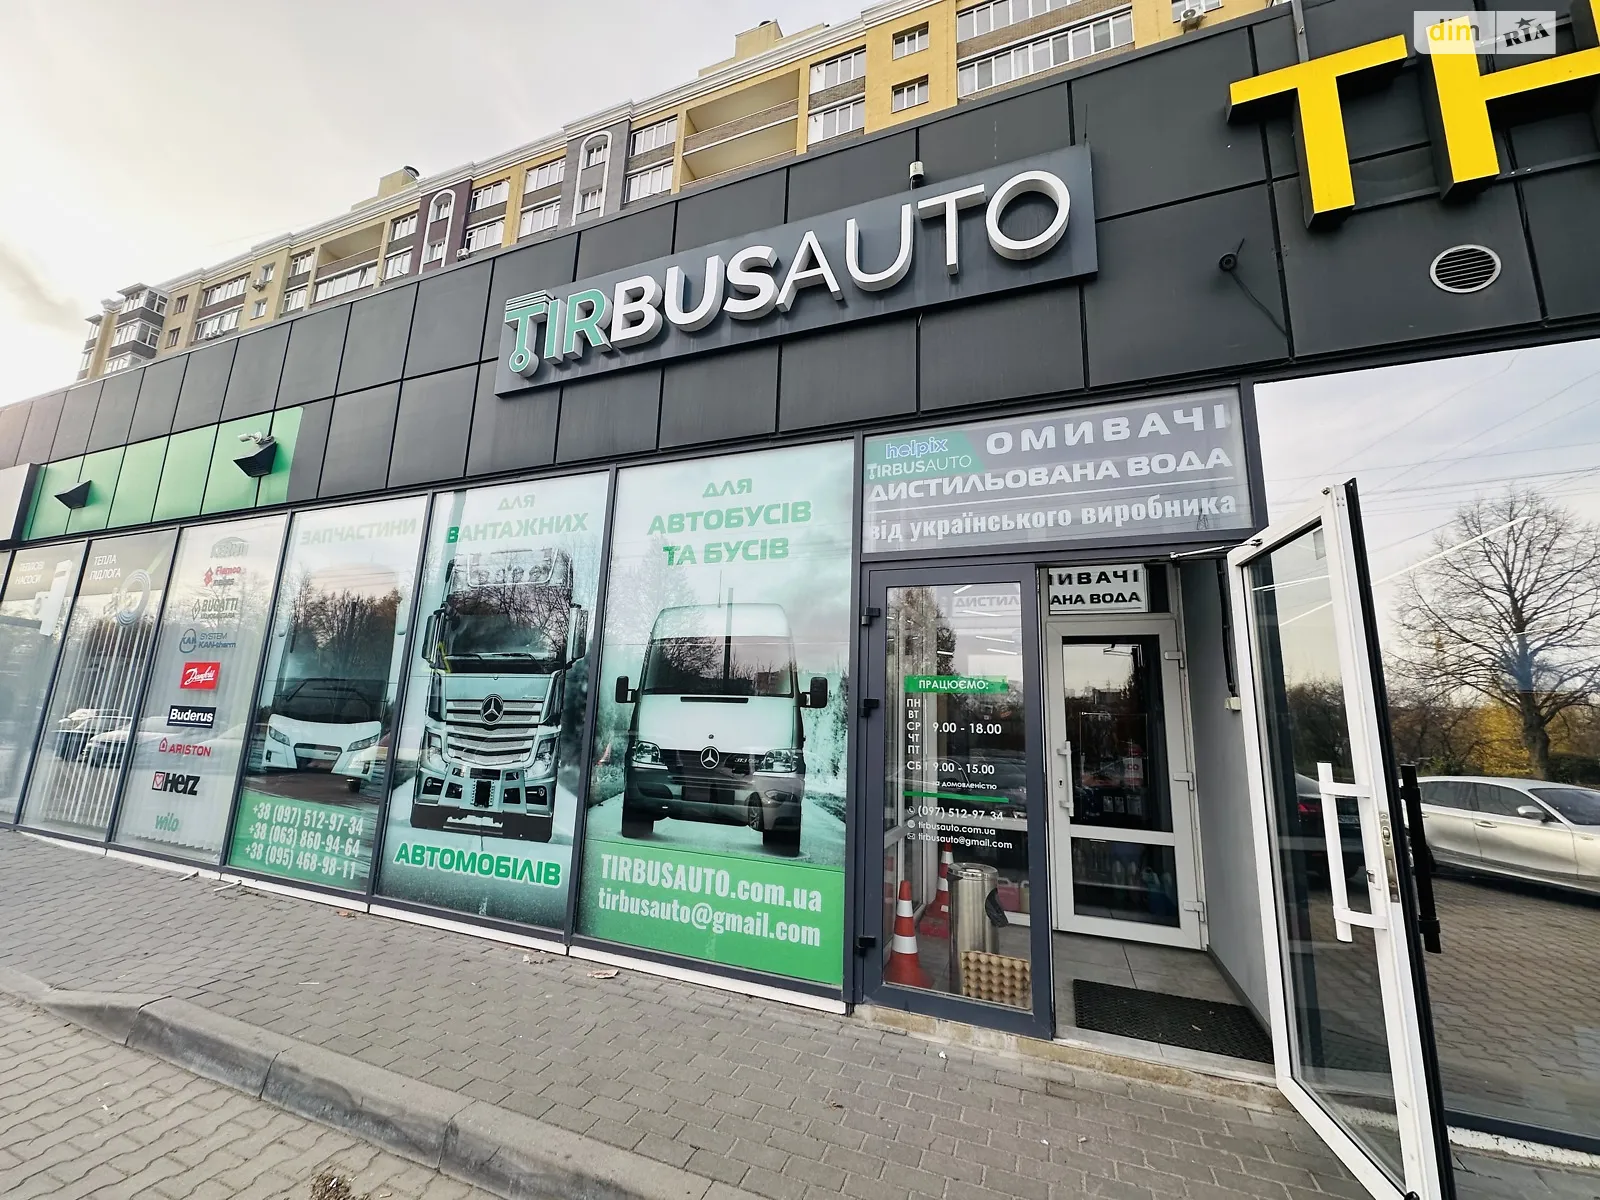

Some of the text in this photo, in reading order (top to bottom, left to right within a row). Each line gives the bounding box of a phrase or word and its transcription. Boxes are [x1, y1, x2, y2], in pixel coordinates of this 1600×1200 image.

[504, 170, 1071, 378] TIRBUSAUTO
[986, 404, 1226, 455] ОМИВАЧІ
[885, 436, 949, 459] helpix
[867, 454, 972, 480] TIRBUSAUTO
[867, 448, 1232, 502] ДИСТИЛЬОВАНА ВОДА
[702, 478, 752, 498] ДЛЯ
[497, 494, 535, 511] ДЛЯ
[648, 501, 811, 535] АВТОБУСІВ
[870, 494, 1236, 543] від українського виробника
[300, 518, 417, 546] ЗАПЧАСТИНИ
[446, 512, 588, 544] ВАНТАЖНИХ
[663, 537, 789, 566] ТА БУСІВ
[94, 555, 117, 565] ТЕПЛА
[89, 568, 121, 581] ПІДЛОГА
[955, 596, 1021, 608] ДИСТИЛ
[1050, 592, 1142, 605] АНА ВОДА
[182, 636, 197, 644] KAN
[200, 632, 228, 640] SYSTEM
[919, 680, 989, 690] ПРАЦЮЄМО:
[907, 698, 921, 707] ПН
[170, 708, 214, 723] Buderus
[908, 710, 919, 719] ВТ
[907, 722, 921, 731] СР
[933, 722, 957, 733] 9.00
[969, 723, 1002, 735] 18.00
[908, 733, 920, 742] ЧТ
[168, 744, 212, 757] ARISTON
[908, 745, 920, 754] ПТ
[907, 761, 922, 770] СБ
[933, 763, 955, 772] 9.00
[966, 763, 995, 775] 15.00
[941, 781, 998, 790] домовленістю
[253, 802, 364, 836] +38 (097) 512-97-34
[918, 805, 1004, 821] (097) 512-9734
[155, 813, 180, 832] wilo
[918, 821, 996, 836] tirbusauto.com.ua
[249, 821, 361, 858] +38 (063) 860-94-64
[918, 833, 1013, 849] tirbusauto@gmail.com
[245, 841, 356, 880] +38 (095) 468-98-11
[394, 842, 562, 887] АВТОМОБІЛІВ
[601, 853, 822, 912] TIRBUSAUTO.com.ua
[598, 887, 820, 947] tirbusauto@gmail.com
